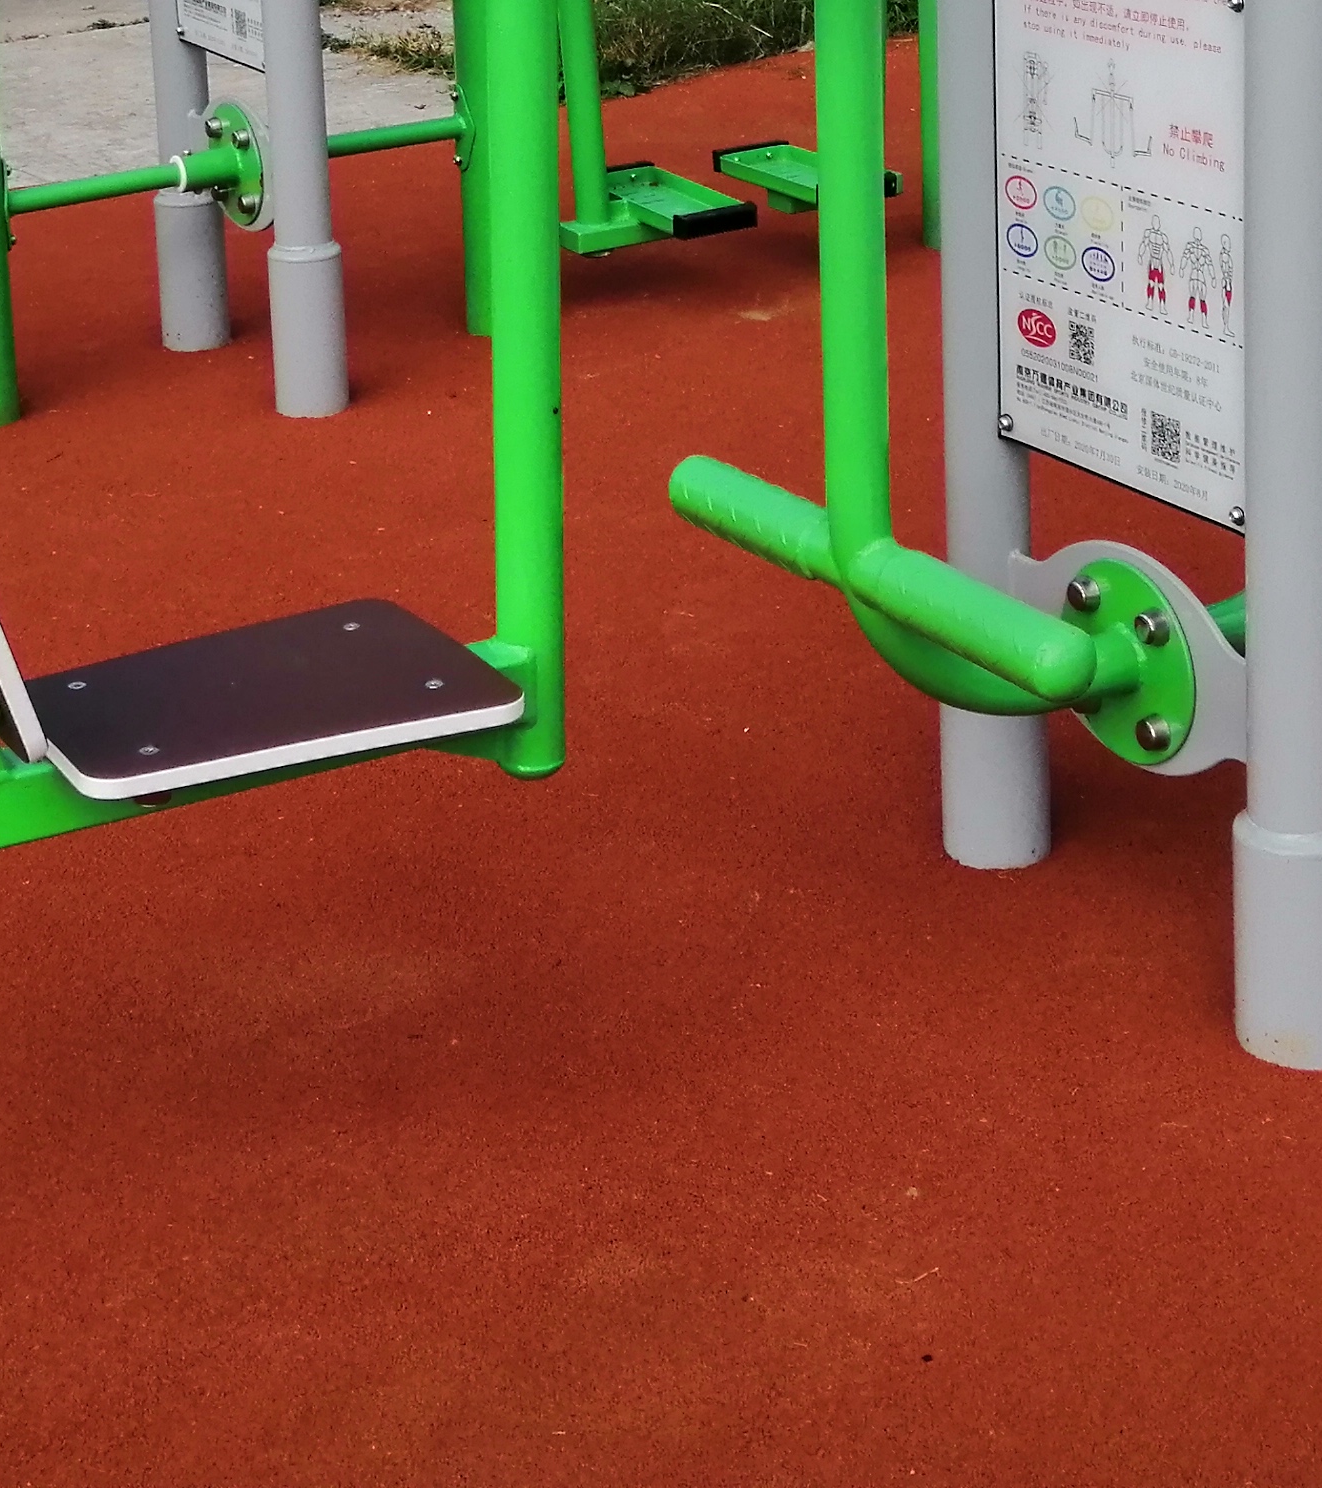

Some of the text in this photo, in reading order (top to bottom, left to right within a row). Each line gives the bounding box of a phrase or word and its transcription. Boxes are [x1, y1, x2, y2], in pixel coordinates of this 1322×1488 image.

[1023, 3, 1032, 14] If
[1035, 6, 1057, 20] there
[1061, 14, 1069, 23] is
[1073, 16, 1087, 27] any
[1089, 18, 1135, 36] discomfort
[1138, 28, 1167, 44] during
[1193, 39, 1222, 54] please
[1023, 20, 1040, 31] stop
[1043, 26, 1065, 38] using
[1069, 30, 1078, 40] it
[1168, 122, 1214, 149] 禁止攀爬
[1162, 142, 1225, 173] No Climbing
[1021, 312, 1053, 339] NSCC
